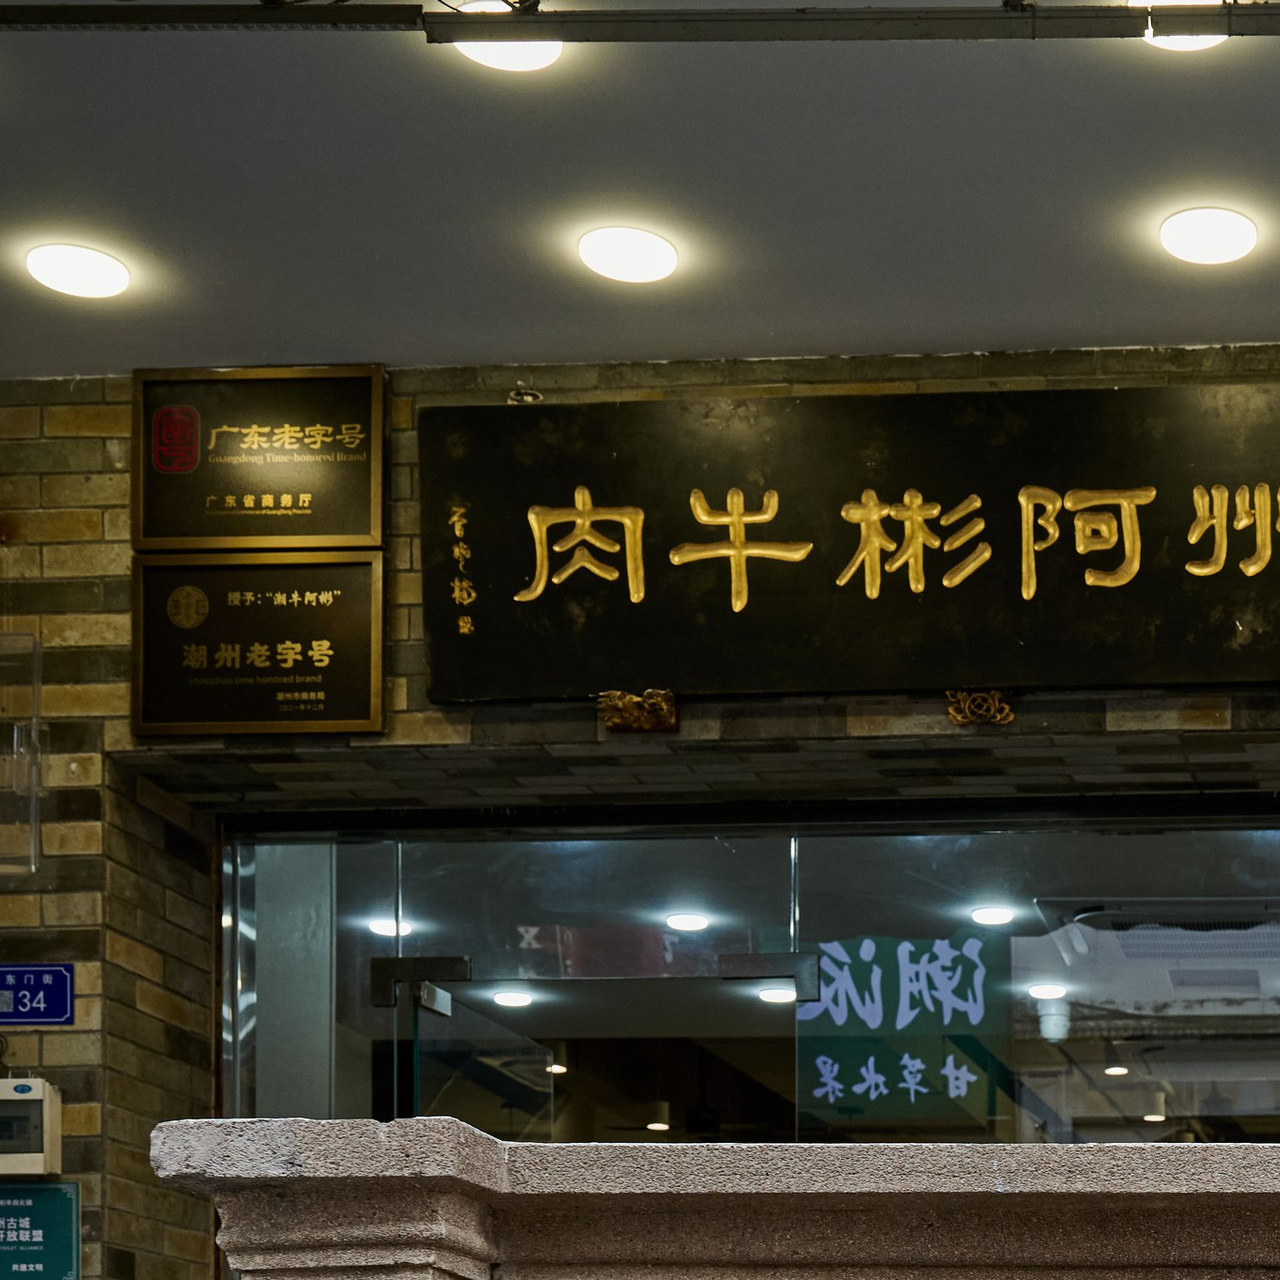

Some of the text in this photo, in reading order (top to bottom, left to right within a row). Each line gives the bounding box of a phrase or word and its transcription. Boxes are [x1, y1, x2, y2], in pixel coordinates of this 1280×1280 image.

[207, 423, 367, 450] 广东老字号
[336, 451, 367, 462] Brand
[182, 639, 334, 669] 潮州老字号
[295, 673, 323, 683] brand
[5, 973, 54, 986] 东门街
[17, 990, 47, 1013] 34
